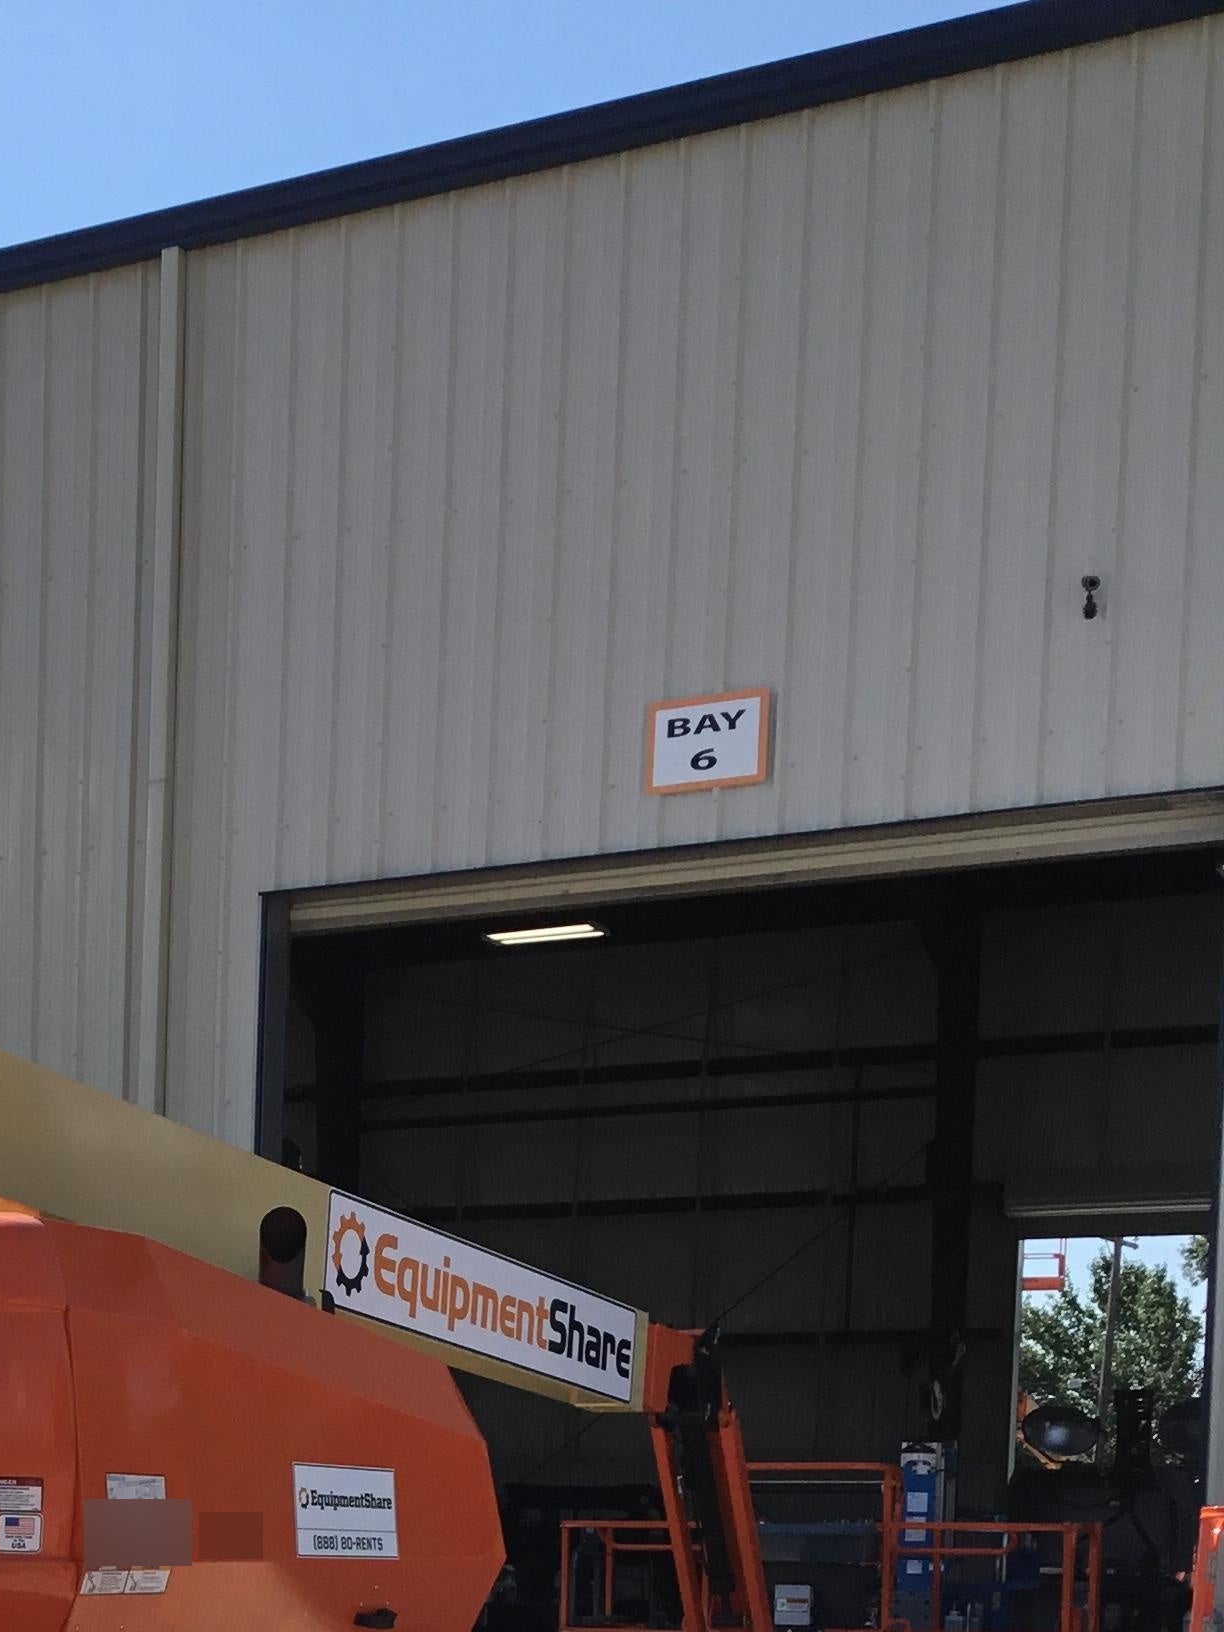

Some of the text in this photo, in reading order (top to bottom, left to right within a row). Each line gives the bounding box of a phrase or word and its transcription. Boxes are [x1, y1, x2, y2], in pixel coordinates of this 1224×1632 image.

[666, 709, 746, 738] BAY
[690, 748, 718, 771] 6
[373, 1232, 632, 1379] EquipmentShare
[310, 1489, 392, 1510] EquipmentShare
[313, 1535, 383, 1551] (888) 80-RENTS
